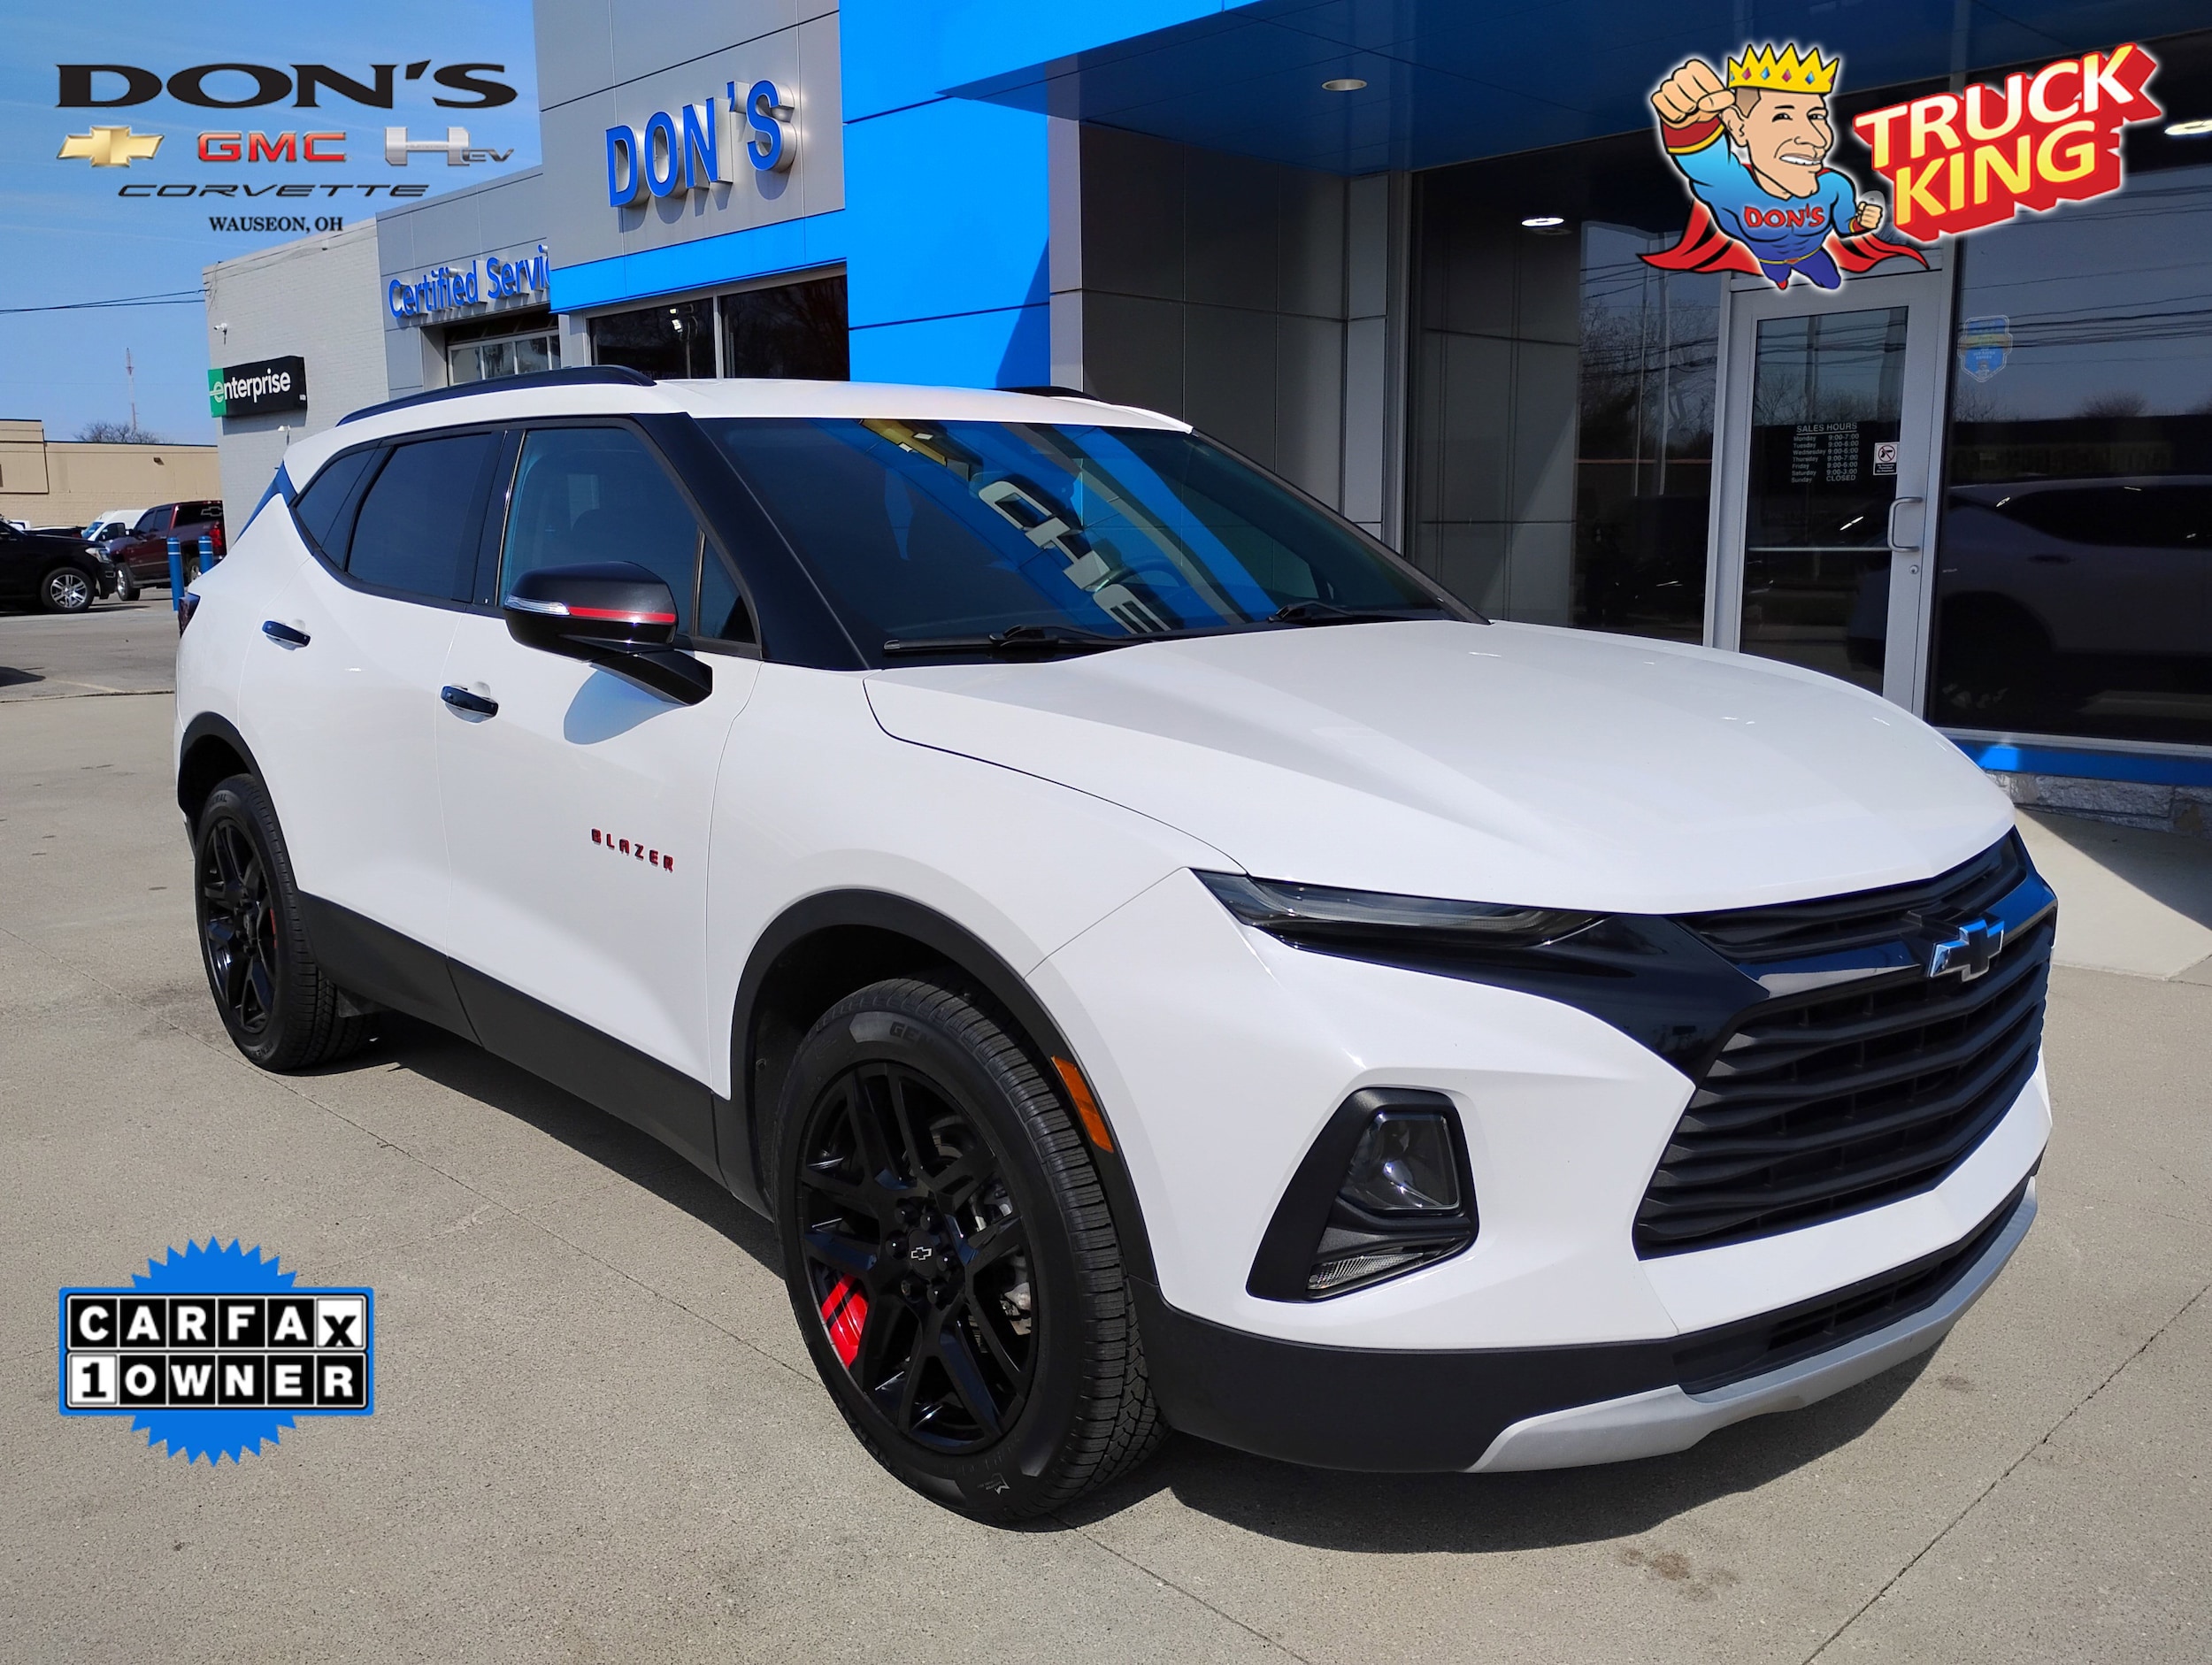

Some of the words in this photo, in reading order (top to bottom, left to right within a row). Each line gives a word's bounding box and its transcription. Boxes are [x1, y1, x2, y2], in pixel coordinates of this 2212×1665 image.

[605, 80, 789, 208] DON'S
[388, 259, 479, 318] Certified
[210, 368, 291, 403] enterprise
[1796, 424, 1824, 433] SALES
[1826, 422, 1857, 431] HOURS
[591, 828, 673, 872] BLAZER
